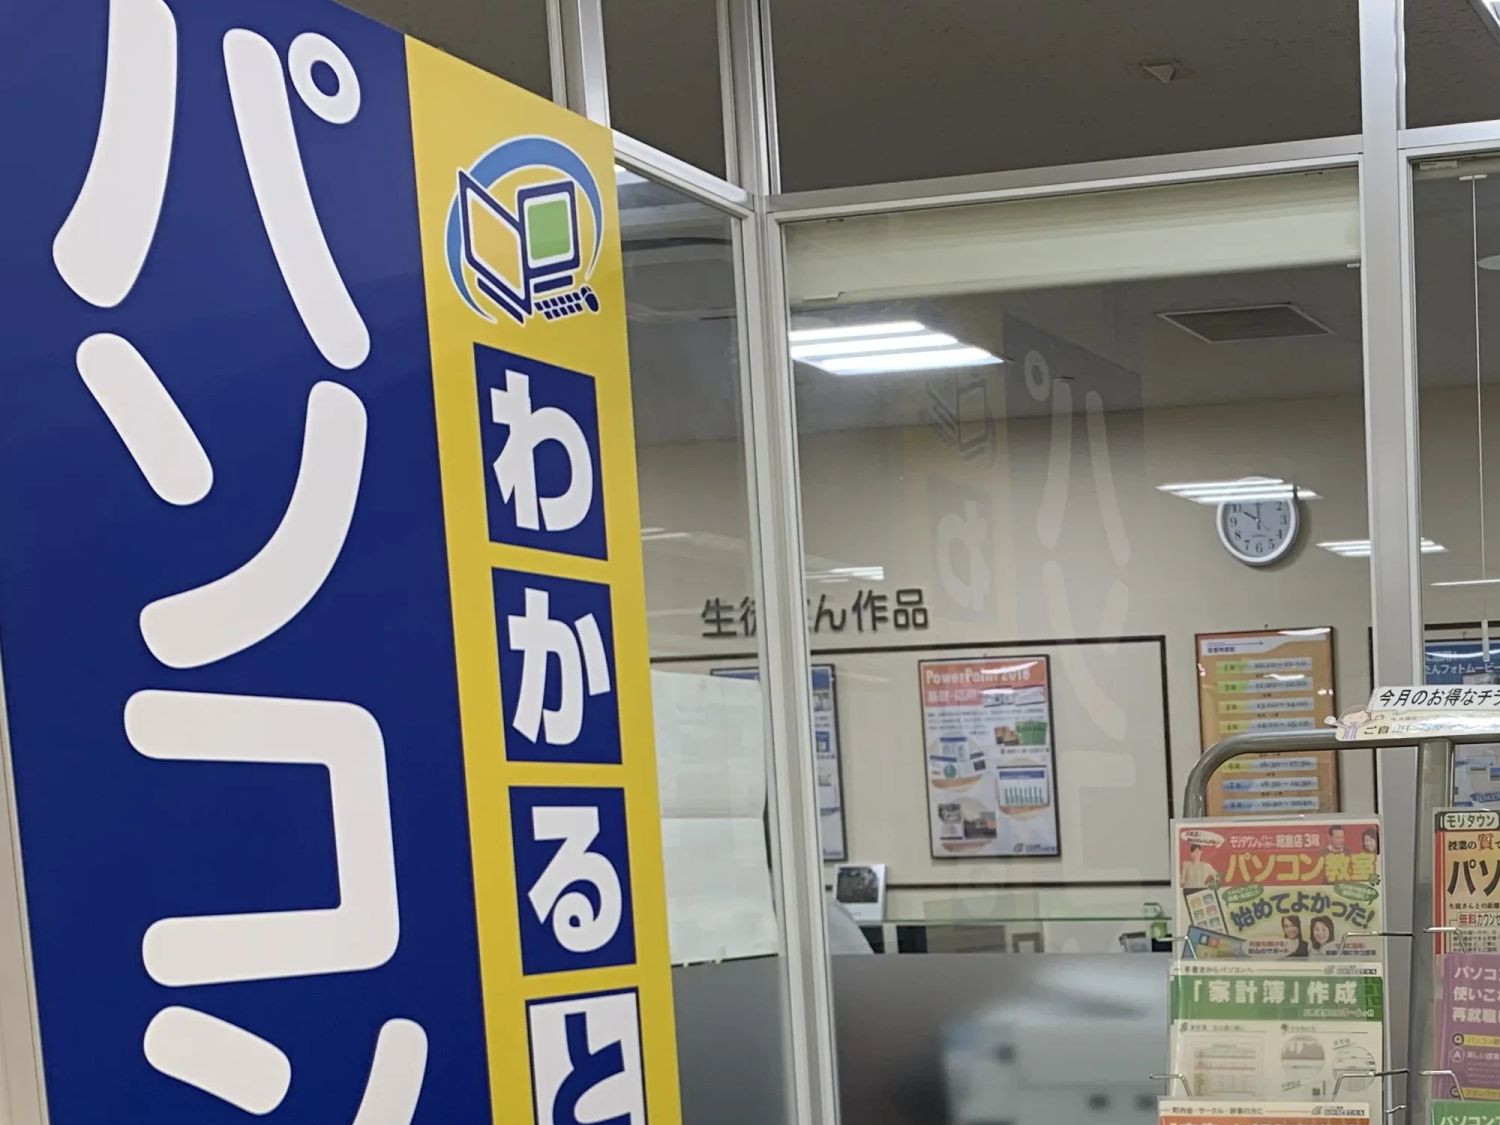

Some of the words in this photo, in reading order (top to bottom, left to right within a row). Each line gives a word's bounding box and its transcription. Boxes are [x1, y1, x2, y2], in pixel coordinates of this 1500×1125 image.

[701, 588, 930, 639] 生ん作品
[1446, 813, 1496, 828] モリタウン
[1225, 851, 1377, 883] パソコン教室
[1230, 891, 1376, 932] 始めてよかった!
[1193, 979, 1358, 1005] 「家計簿」作成
